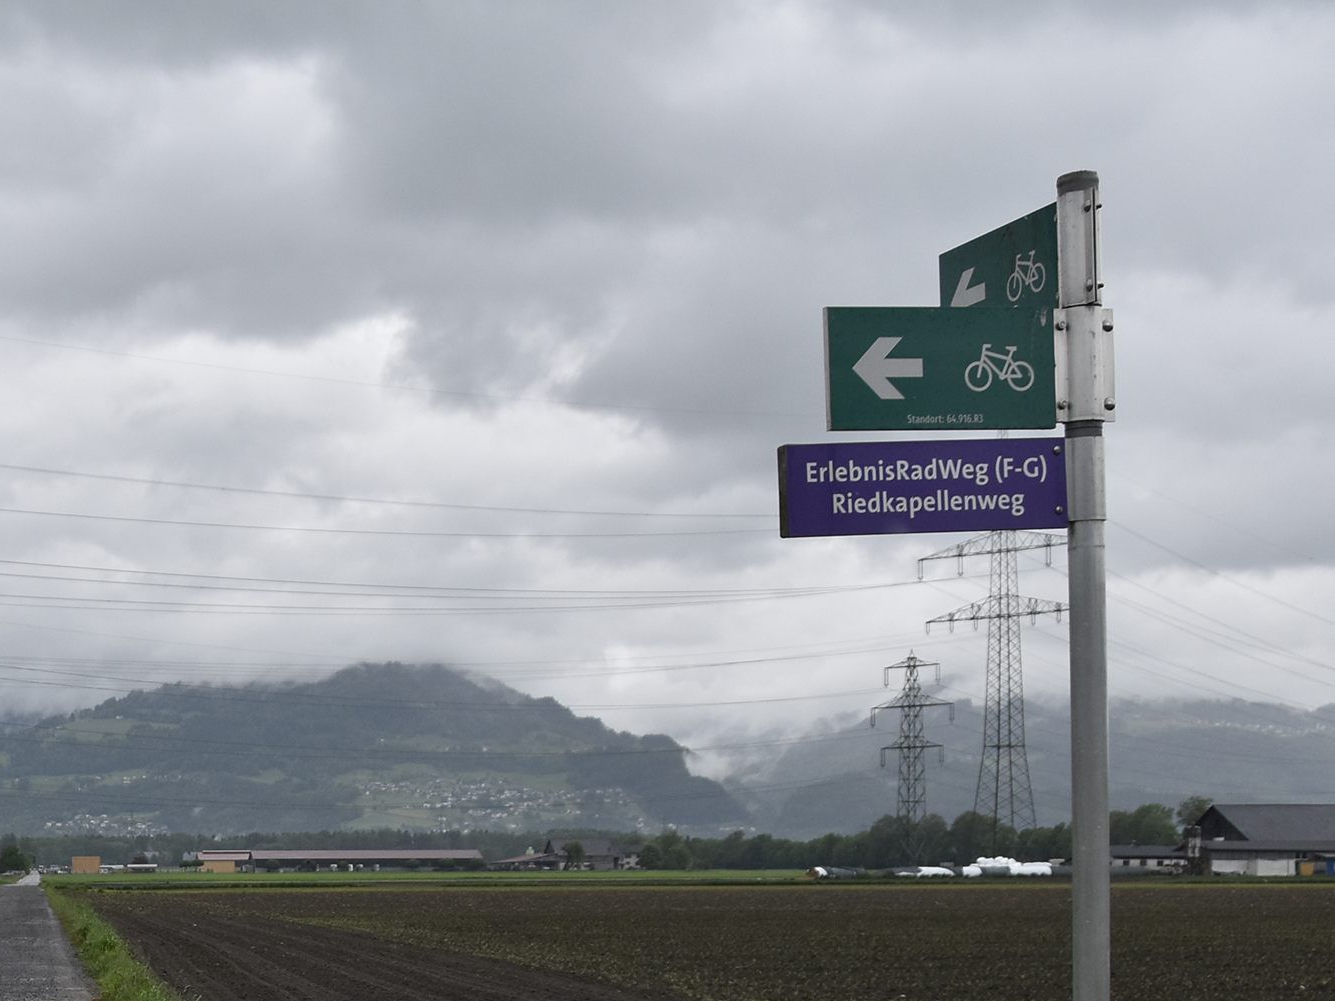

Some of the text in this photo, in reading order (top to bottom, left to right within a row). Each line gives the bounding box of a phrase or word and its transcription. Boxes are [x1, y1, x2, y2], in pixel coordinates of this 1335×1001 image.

[906, 413, 944, 424] Standort:
[806, 455, 1047, 485] ErlebnisRadWeg (F-G)
[832, 490, 1025, 518] Riedkapellenweg
